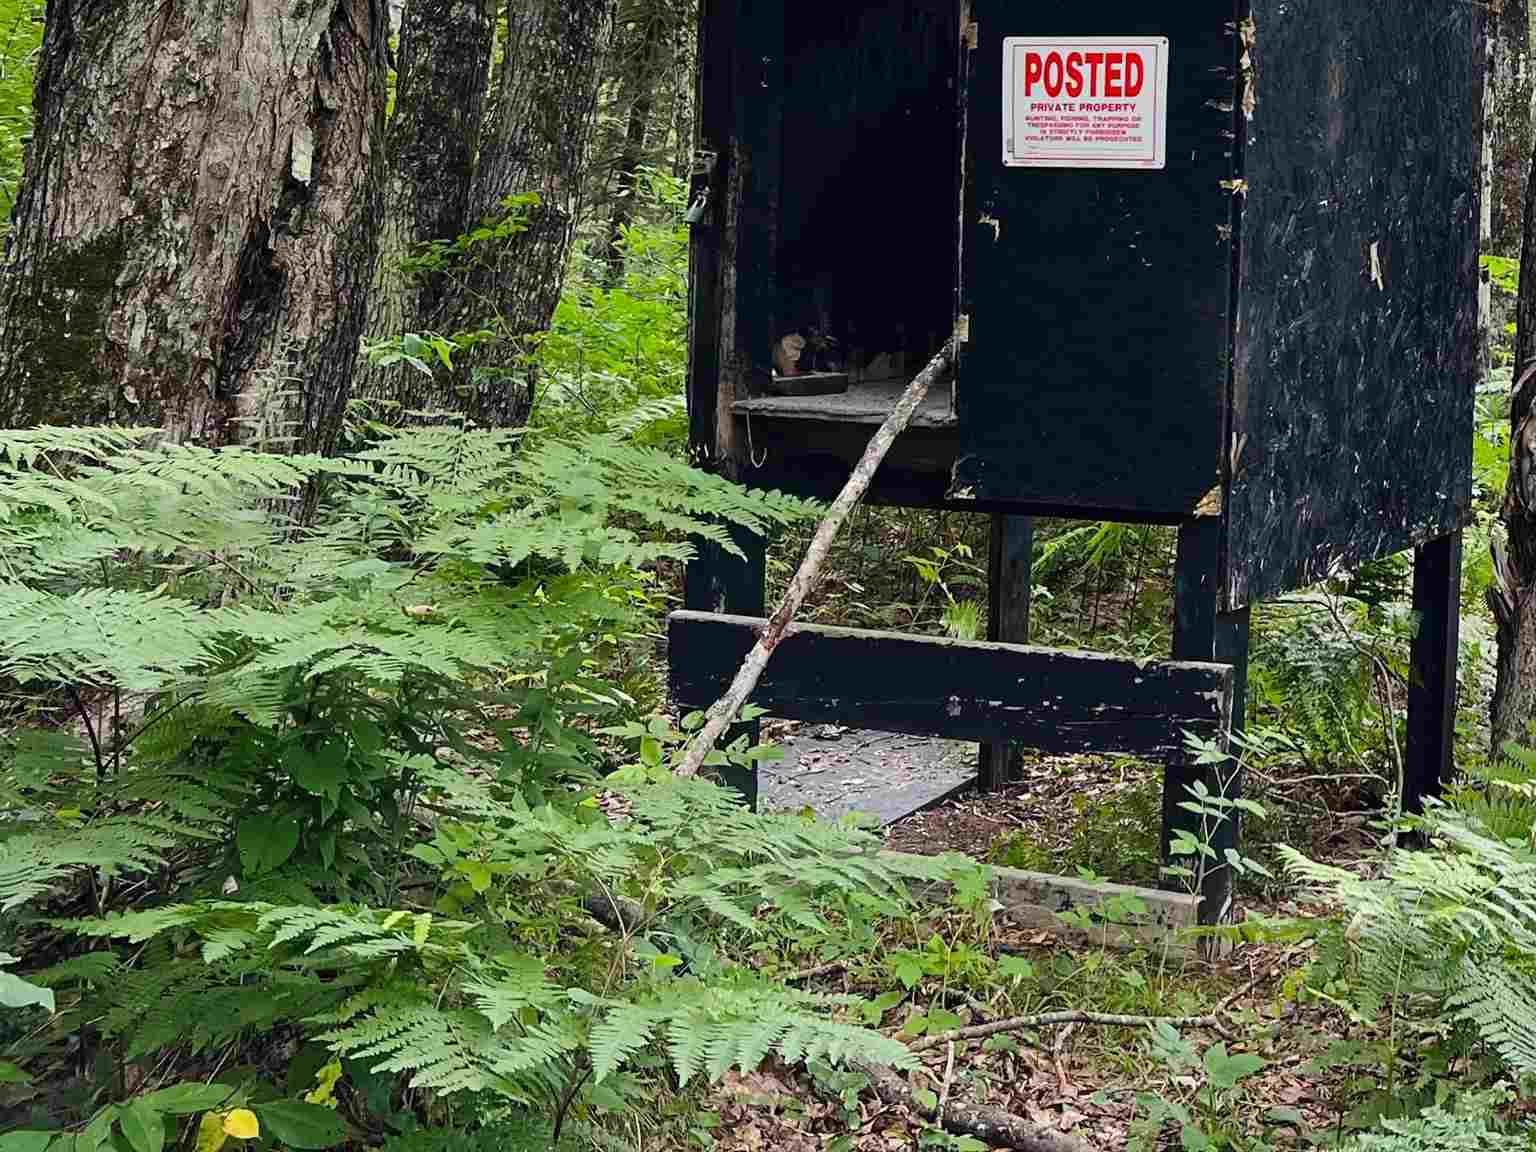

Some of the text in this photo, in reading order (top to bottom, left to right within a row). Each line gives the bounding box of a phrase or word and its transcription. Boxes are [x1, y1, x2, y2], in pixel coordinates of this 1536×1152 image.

[1024, 51, 1144, 98] POSTED
[1031, 103, 1136, 112] PRIVATE PROPERTY
